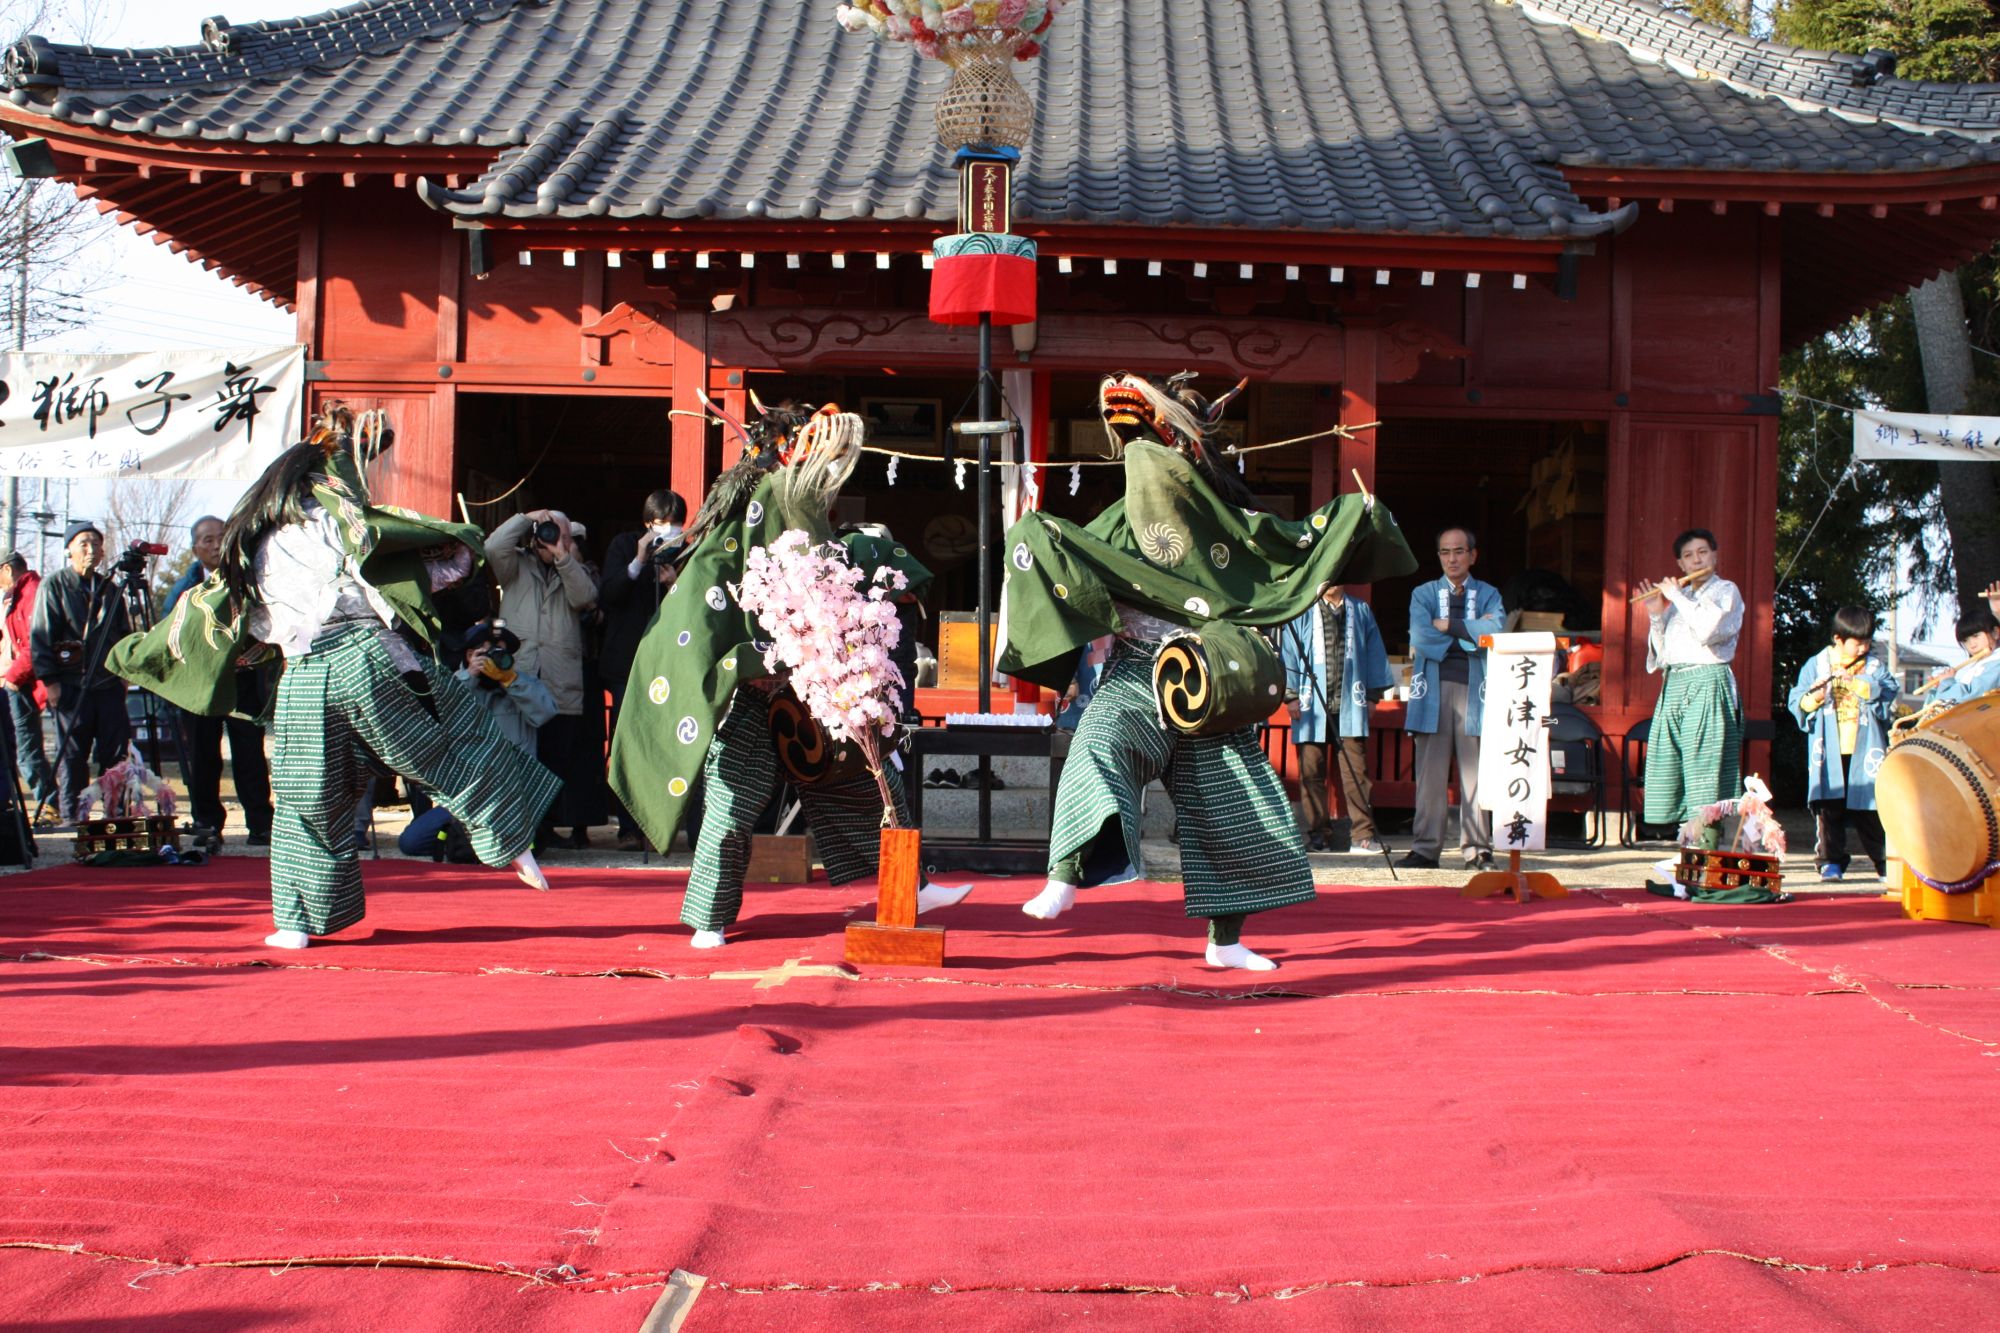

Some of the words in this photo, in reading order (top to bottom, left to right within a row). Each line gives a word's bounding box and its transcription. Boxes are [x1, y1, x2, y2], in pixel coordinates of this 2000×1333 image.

[0, 361, 277, 444] 獅子舞
[1504, 655, 1537, 848] 宇津女の舞
